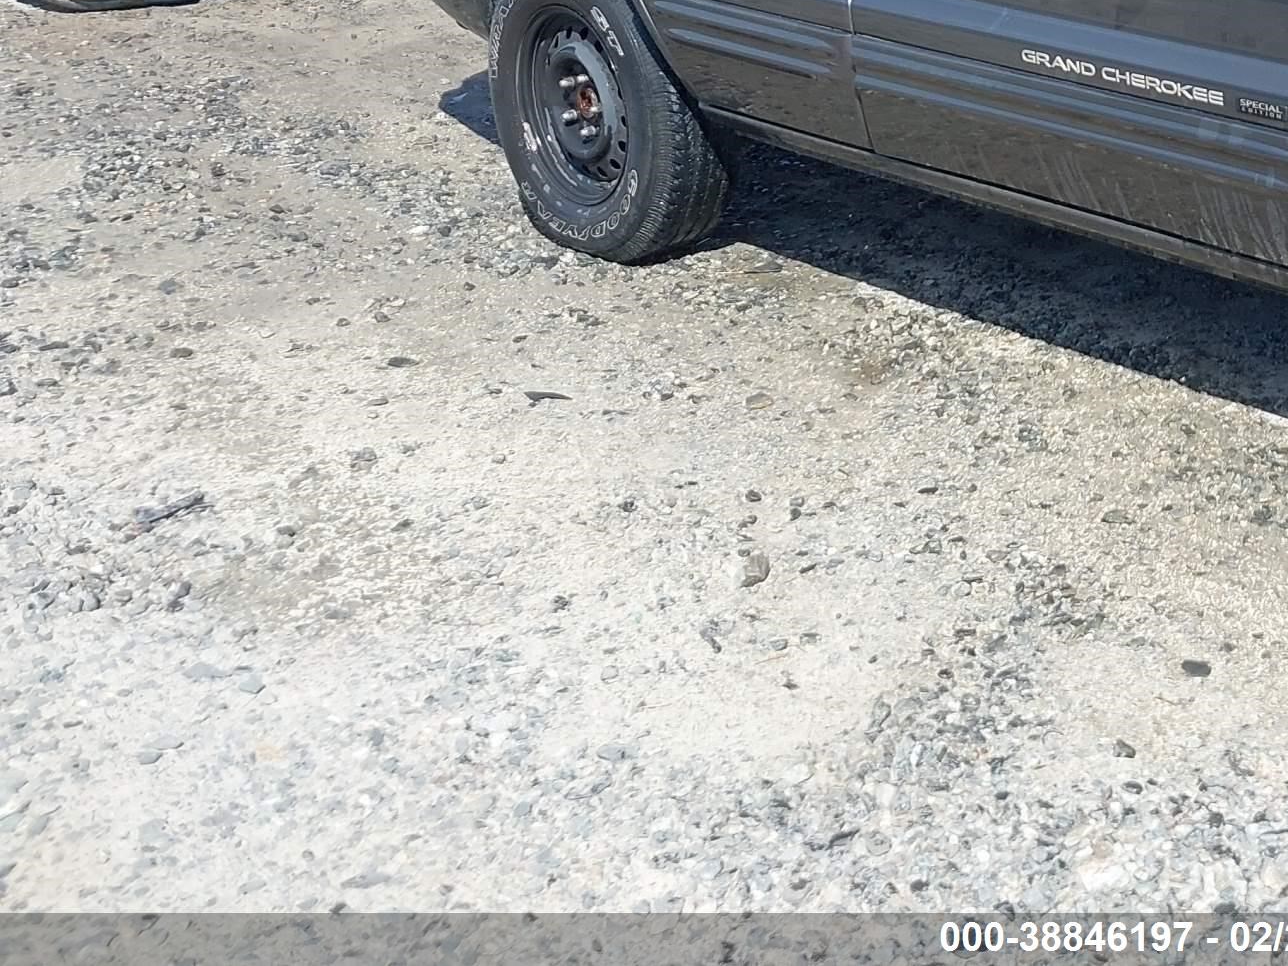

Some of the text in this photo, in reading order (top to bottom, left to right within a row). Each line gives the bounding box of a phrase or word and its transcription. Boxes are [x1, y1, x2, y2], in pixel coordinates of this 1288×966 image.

[590, 6, 624, 55] ST
[1021, 49, 1224, 107] GRAND CHEROKEE
[1240, 98, 1283, 114] SPECIAL
[521, 169, 638, 241] GOODYEAR
